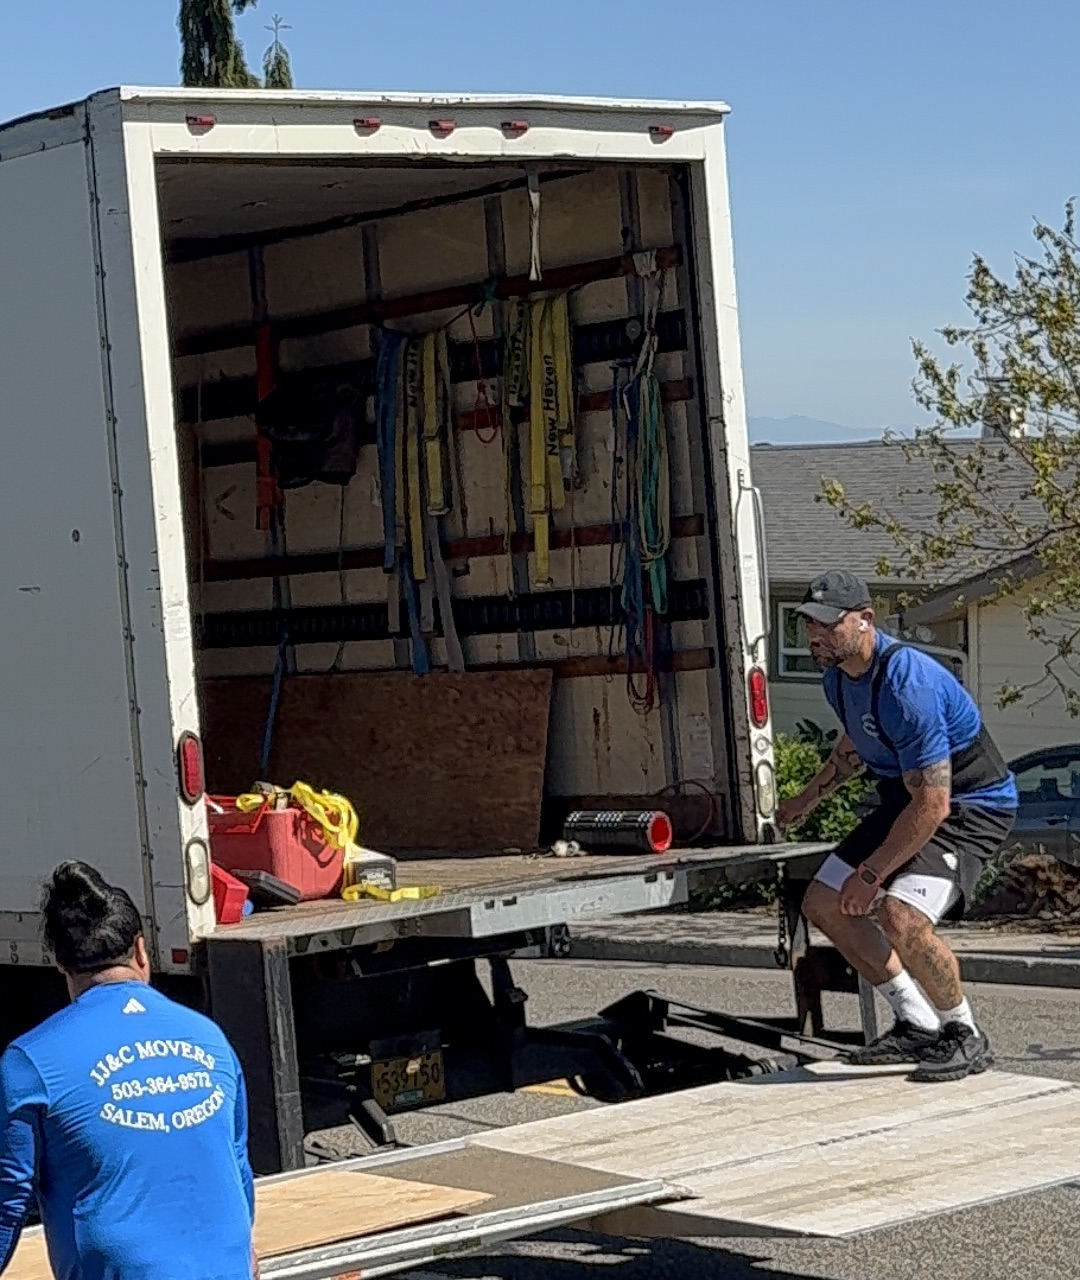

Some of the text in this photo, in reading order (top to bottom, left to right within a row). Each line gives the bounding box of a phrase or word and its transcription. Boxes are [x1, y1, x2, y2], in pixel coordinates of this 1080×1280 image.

[90, 1039, 216, 1086] JJ&C MOVERS
[111, 1071, 212, 1101] 503-364-9572
[99, 1084, 225, 1133] SALEM, OREGON
